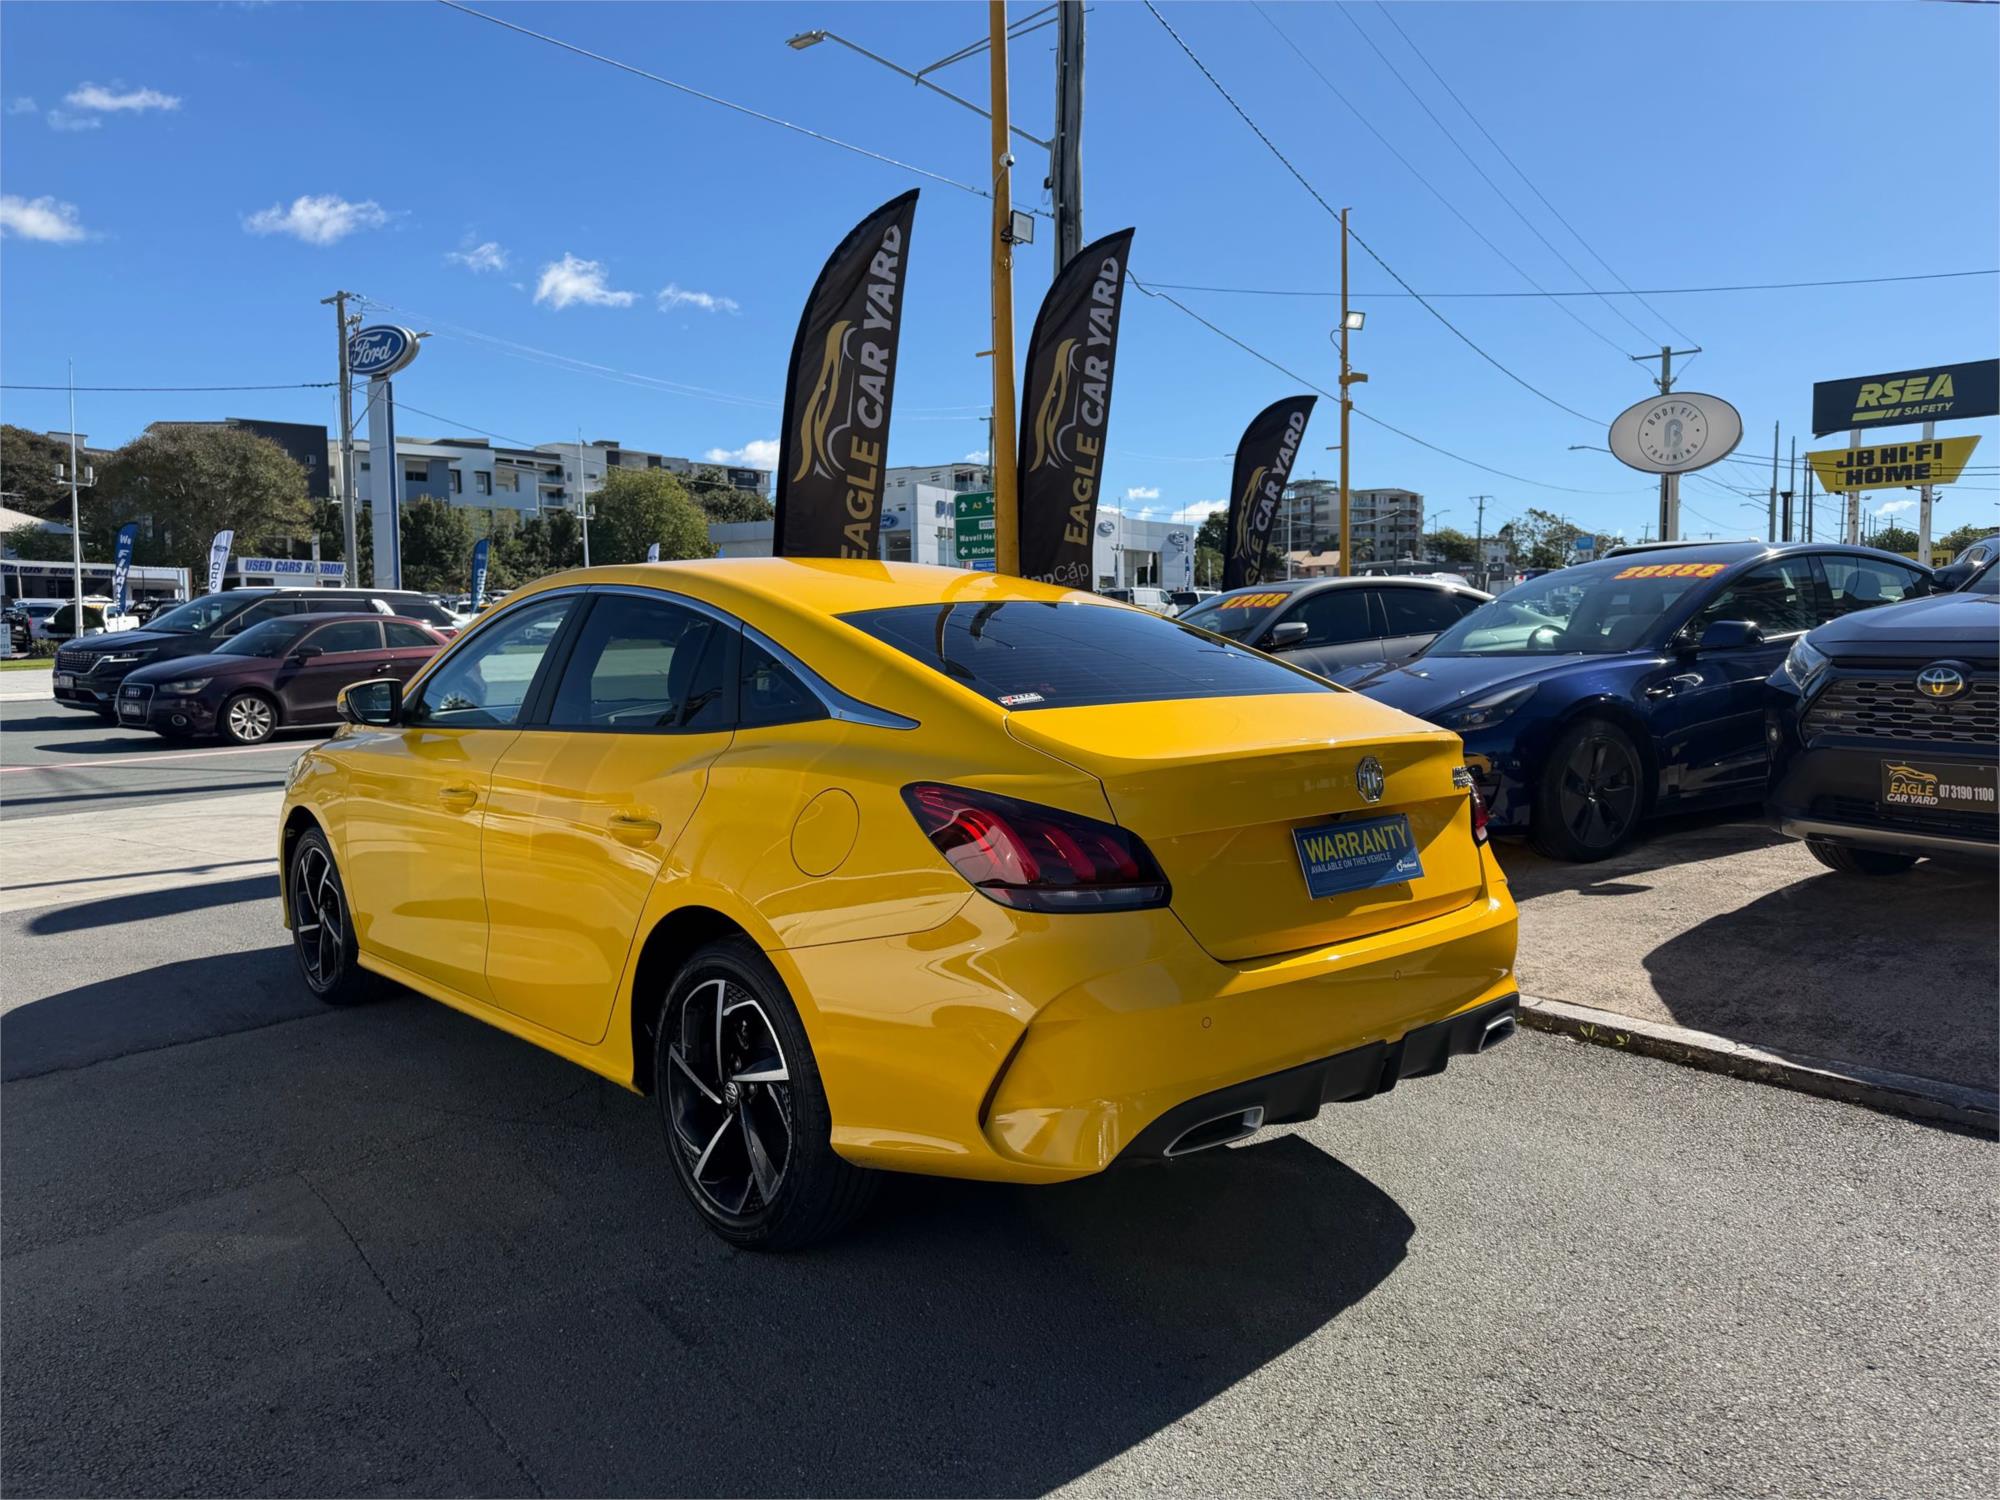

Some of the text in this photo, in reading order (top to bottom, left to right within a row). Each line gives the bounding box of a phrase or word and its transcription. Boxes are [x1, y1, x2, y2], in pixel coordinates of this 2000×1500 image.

[863, 224, 902, 331] YARD
[1087, 256, 1120, 346] YARD
[350, 334, 393, 367] Ford
[857, 341, 890, 429] CAR
[1081, 356, 1109, 427] CAR
[1855, 373, 1955, 408] RSEA
[1647, 406, 1698, 426] BODY FIT
[1903, 401, 1954, 417] SAFETY
[1646, 443, 1698, 461] TRAINING
[1836, 450, 1875, 468] JB
[1846, 463, 1932, 487] HOME
[1064, 432, 1100, 546] EAGLE
[1245, 411, 1305, 586] GLE CAR YARD
[960, 533, 982, 542] Wavell
[210, 561, 221, 592] ORD
[245, 559, 344, 575] USED CARS KRON
[1887, 793, 1939, 805] CAR YARD
[1890, 782, 1935, 796] EAGLE
[1939, 784, 1995, 802] 07 3190 1100
[1303, 822, 1409, 864] WARRANTY
[1311, 851, 1392, 874] AVAILABLE ON THIS VEHICLE
